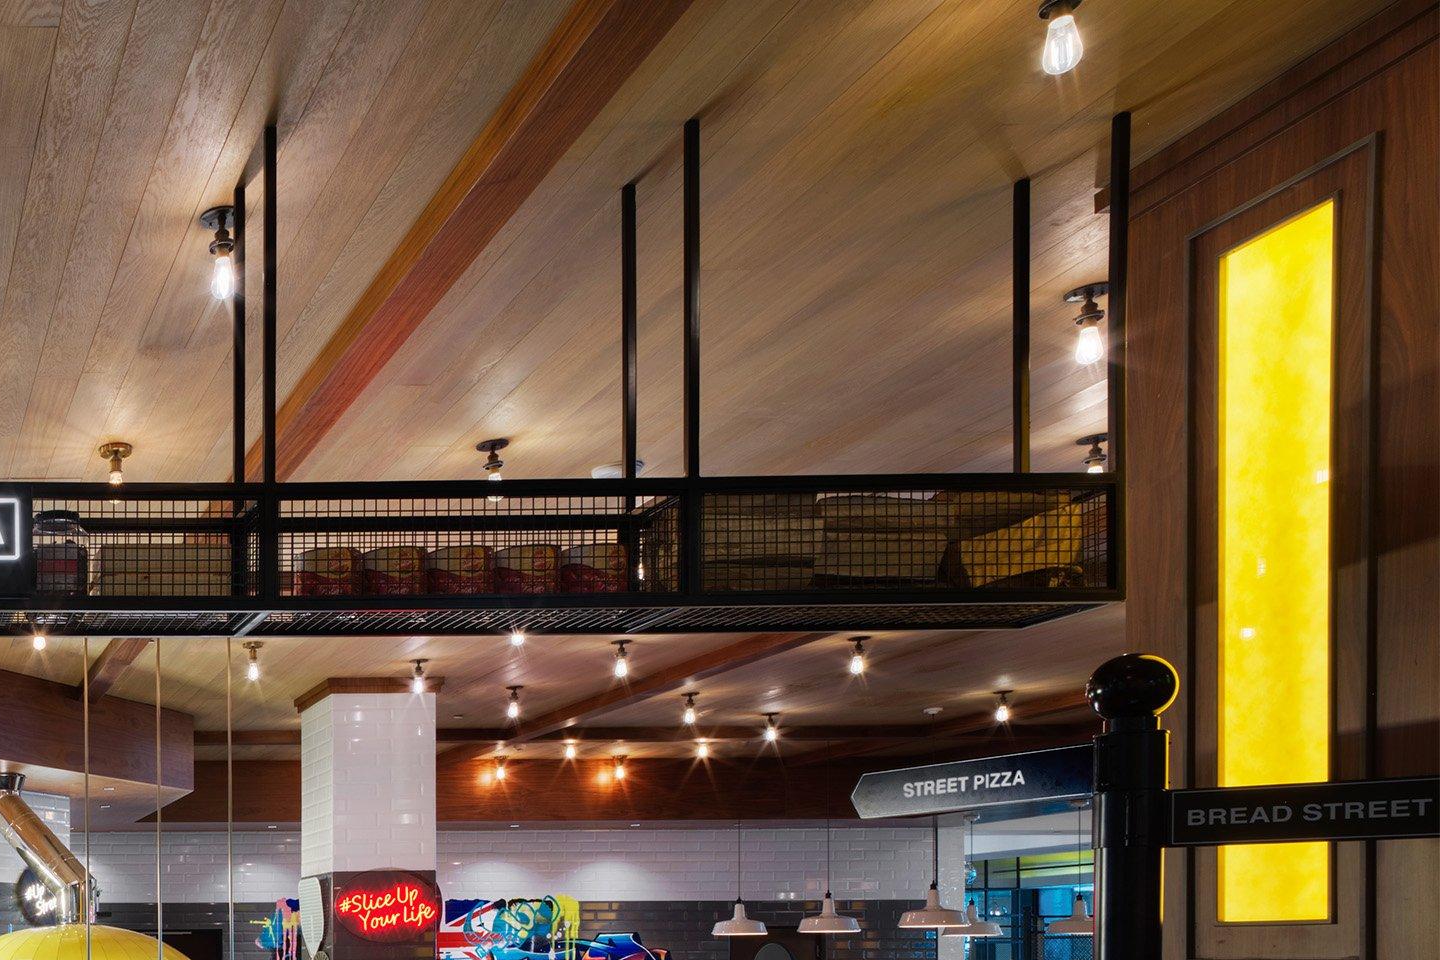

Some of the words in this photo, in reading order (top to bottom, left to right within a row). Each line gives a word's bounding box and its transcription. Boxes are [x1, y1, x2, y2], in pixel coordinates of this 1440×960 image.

[902, 776, 969, 798] STREET
[973, 769, 1026, 791] PIZZA
[1186, 805, 1293, 827] BREAD
[1302, 798, 1433, 822] STREET
[339, 893, 396, 913] #Slice
[397, 886, 419, 907] Up
[358, 910, 401, 931] Your
[403, 903, 436, 927] Life
